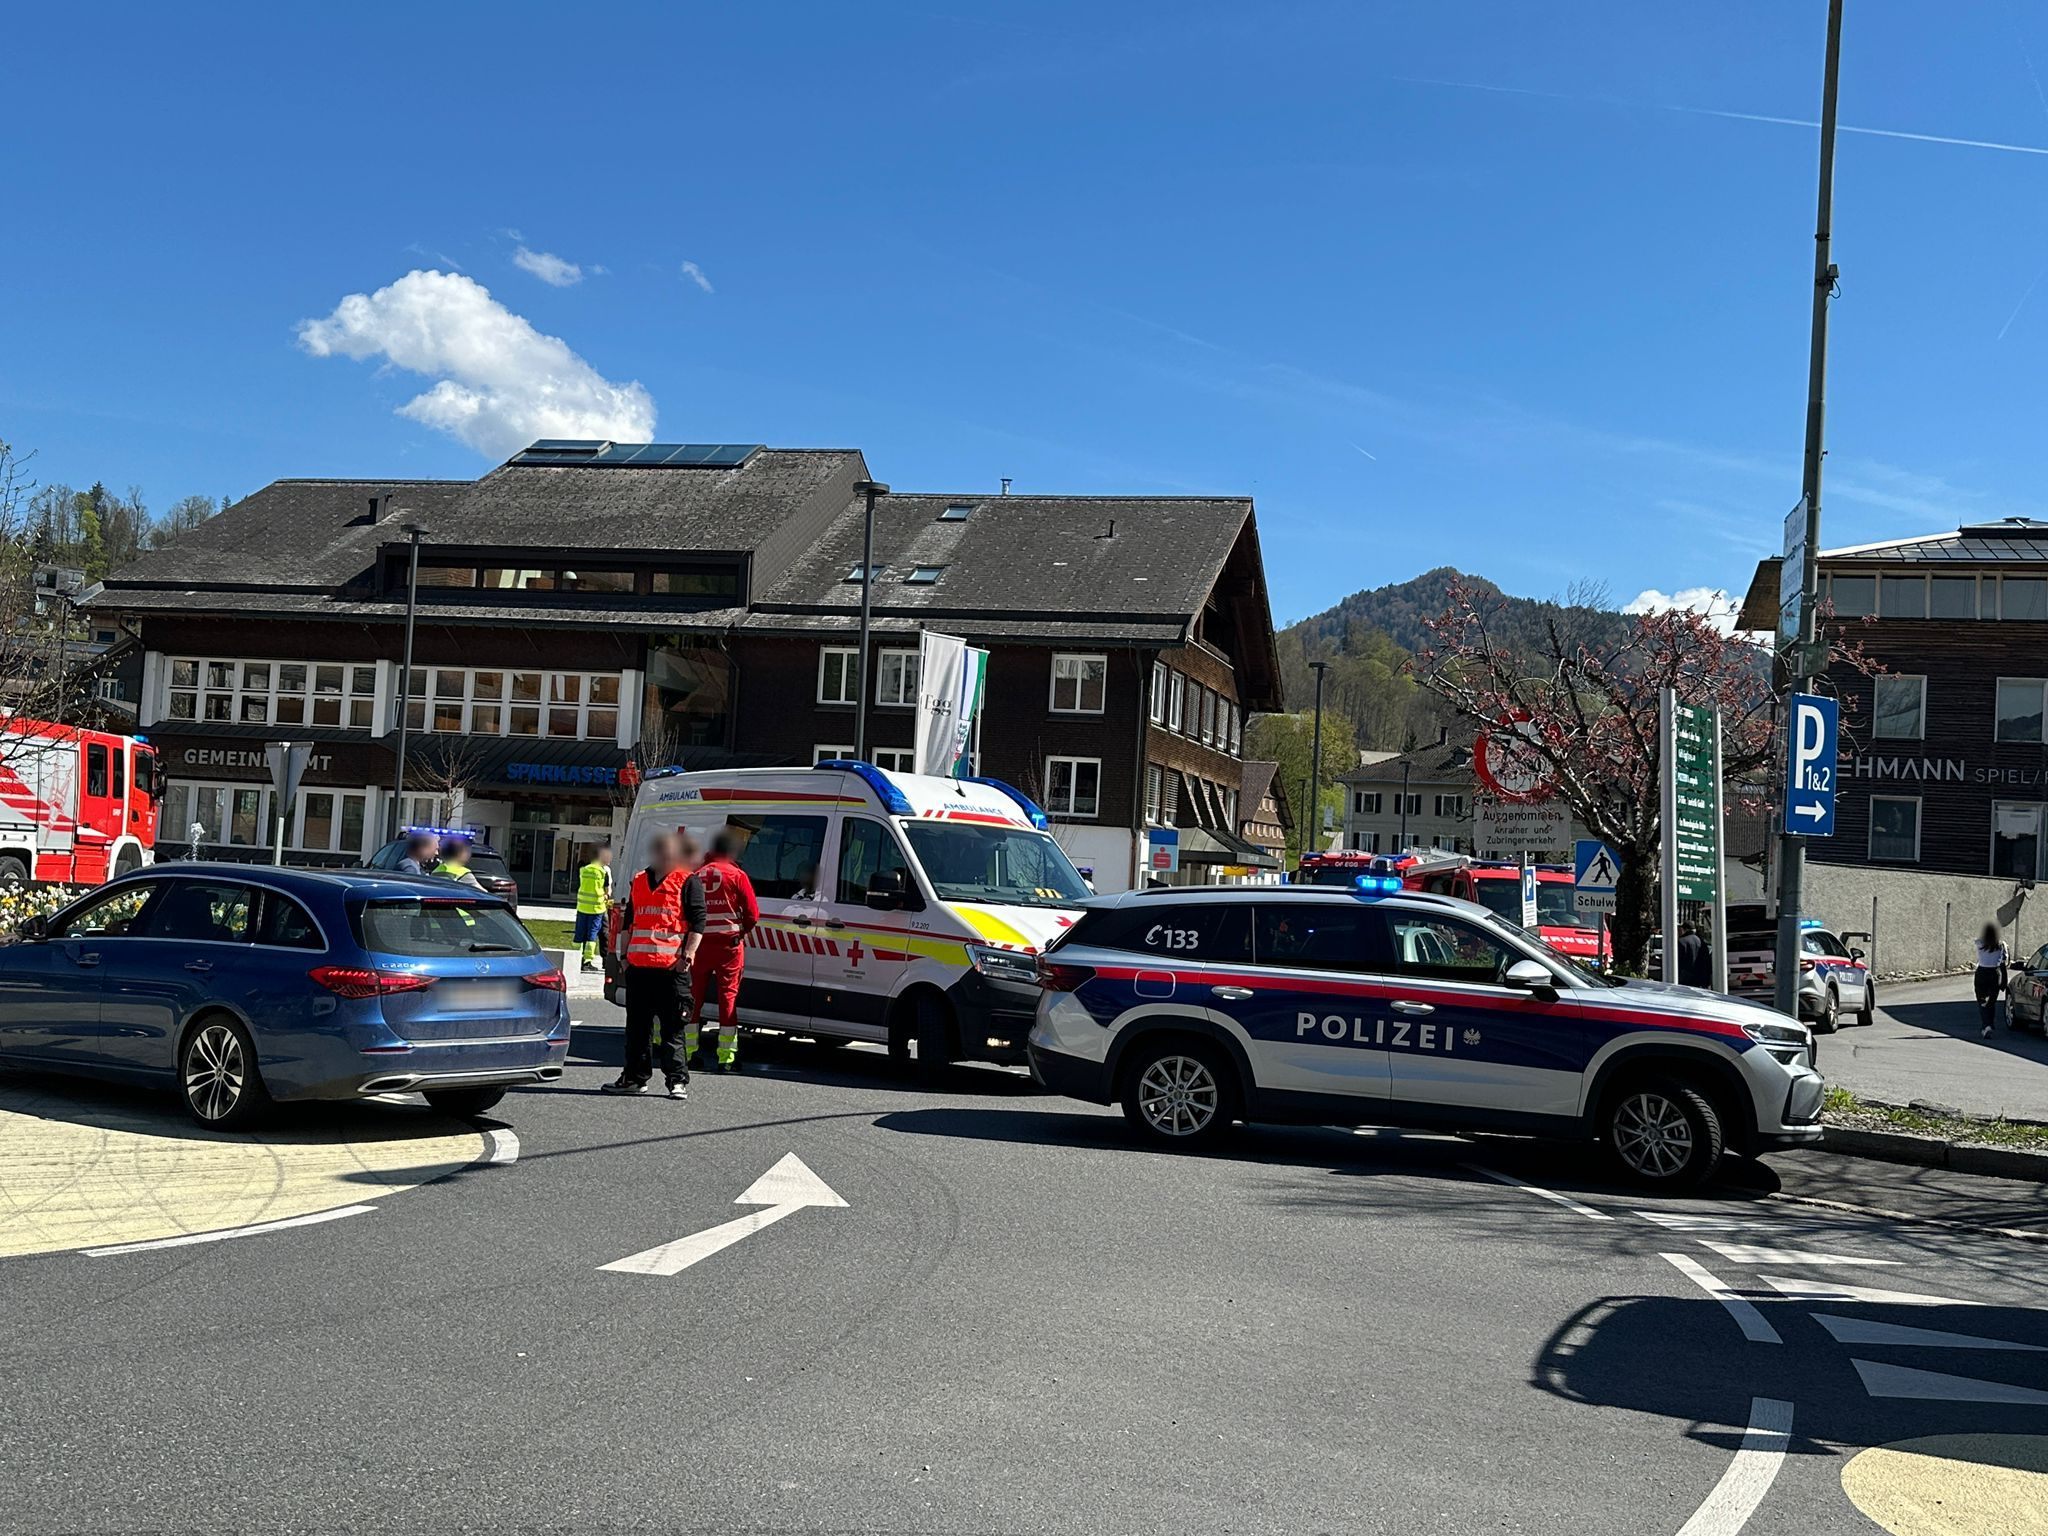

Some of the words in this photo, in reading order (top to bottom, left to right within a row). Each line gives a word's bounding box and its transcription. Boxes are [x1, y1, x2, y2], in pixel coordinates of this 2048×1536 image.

[925, 694, 952, 717] Egg
[1794, 703, 1825, 789] P
[506, 762, 617, 785] SPARKASSE
[1806, 765, 1830, 792] 1&2
[659, 790, 698, 801] AMBULANCE
[943, 802, 1004, 816] AMBULANCE
[1482, 810, 1562, 822] Ausgenommen
[1494, 826, 1529, 835] Anrainer
[1533, 826, 1553, 835] und
[1486, 835, 1557, 847] Zubringerverkehr
[1526, 874, 1533, 897] P
[912, 921, 929, 930] 9.2.202
[1164, 929, 1199, 949] 133
[1296, 1012, 1453, 1051] POLIZEI
